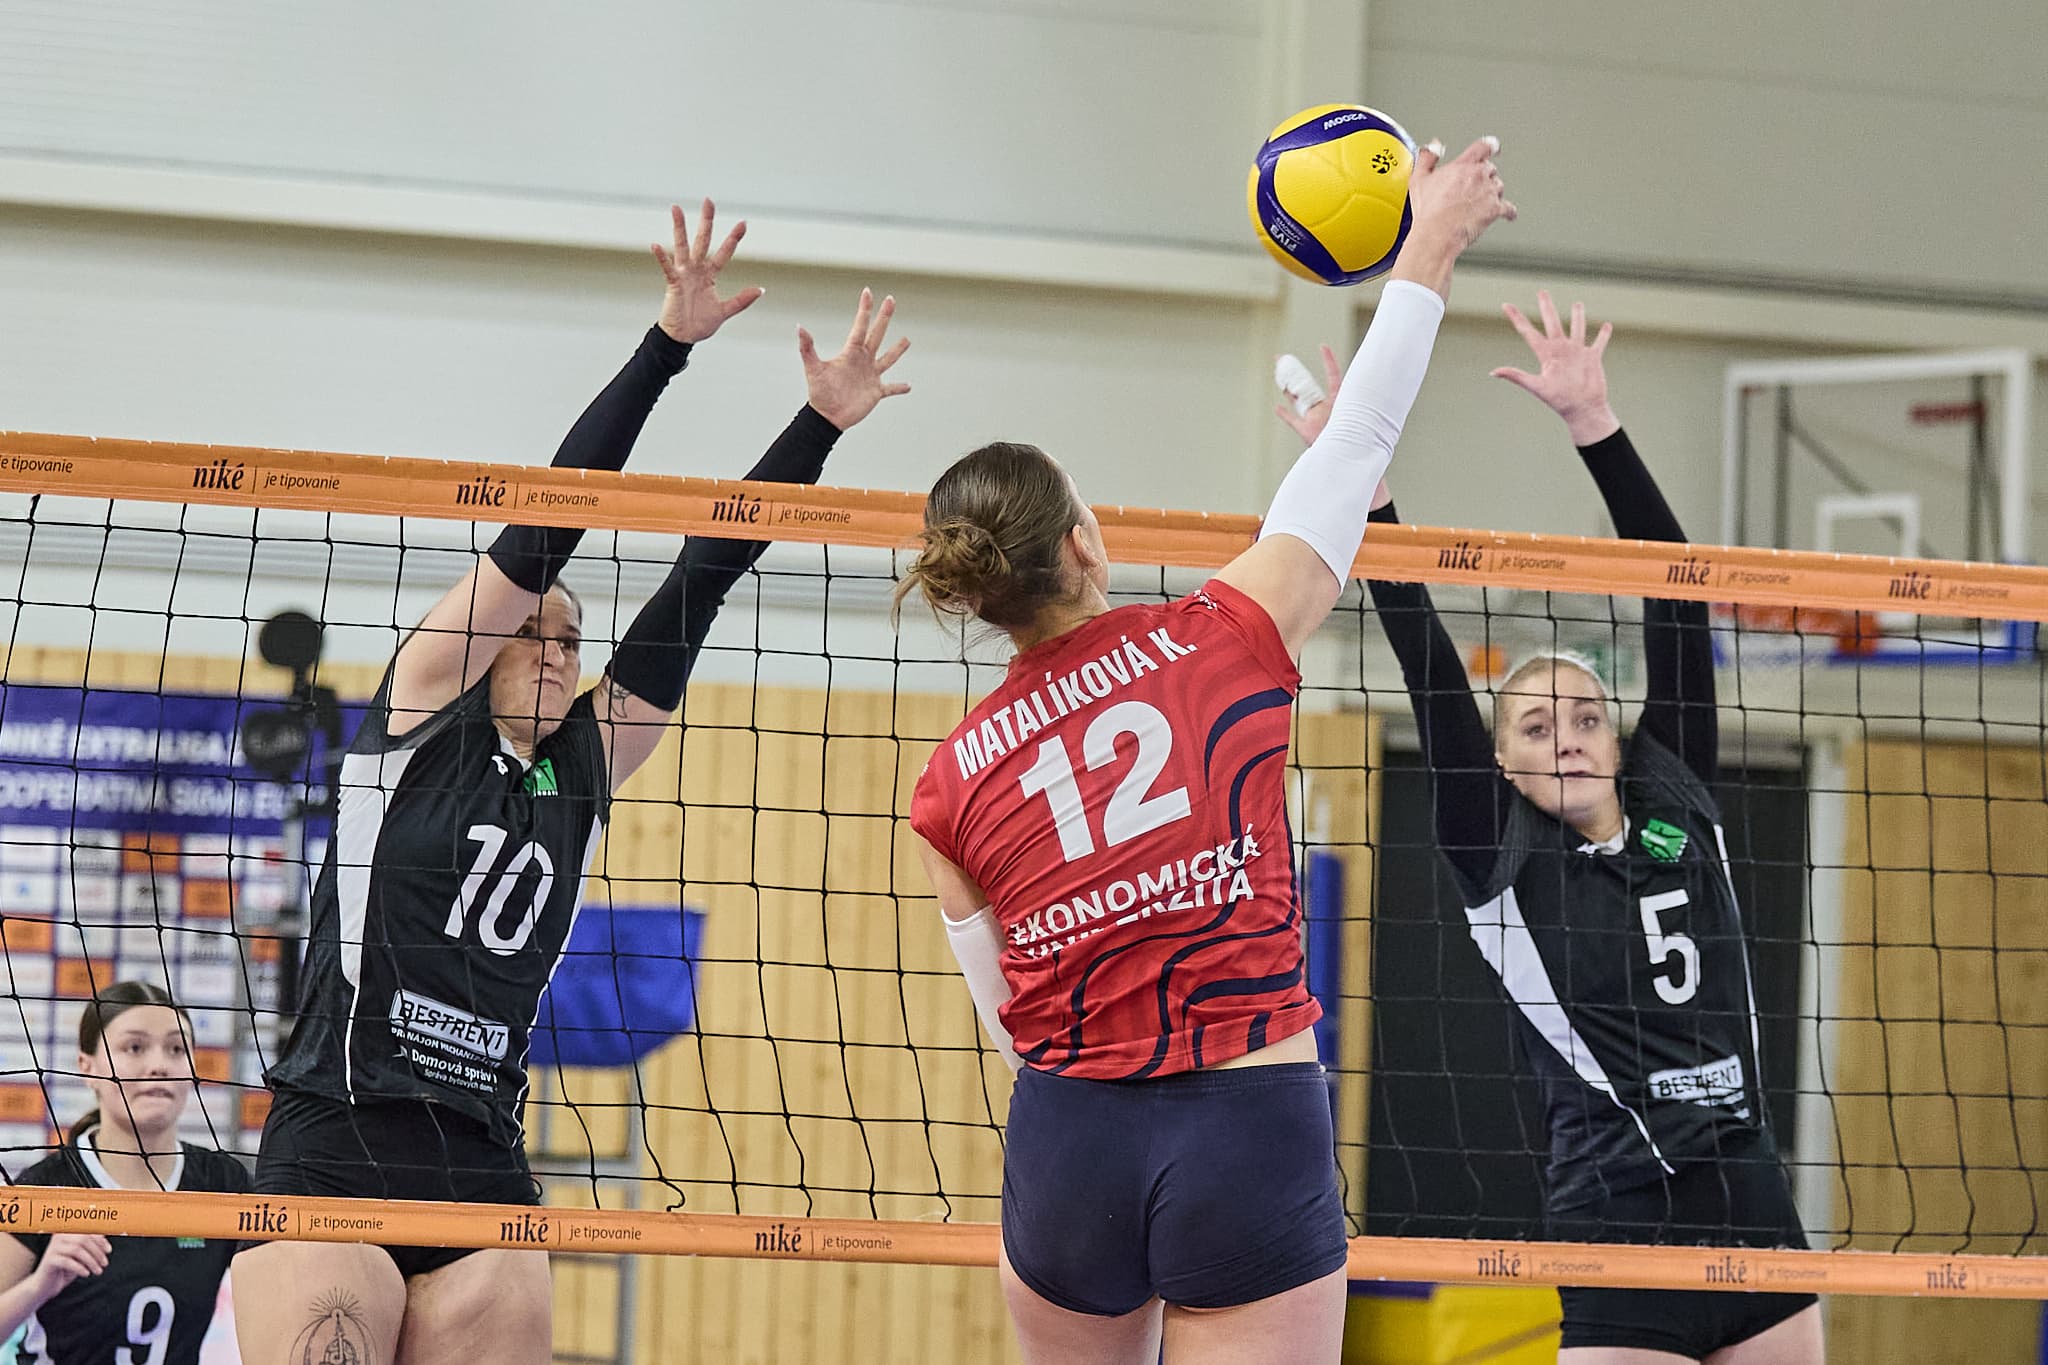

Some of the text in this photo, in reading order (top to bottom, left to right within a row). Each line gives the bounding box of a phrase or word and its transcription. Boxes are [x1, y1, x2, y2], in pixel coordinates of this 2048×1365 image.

[1323, 113, 1367, 130] V200W
[1269, 224, 1298, 252] FIVB
[11, 456, 73, 473] tipovanie
[192, 459, 244, 490] niké
[264, 471, 340, 490] je tipovanie
[456, 476, 506, 507] niké
[525, 489, 599, 508] je tipovanie
[711, 493, 761, 524] niké
[779, 506, 852, 525] je tipovanie
[1437, 541, 1483, 571] niké
[1666, 557, 1711, 586] niké
[1888, 571, 1932, 600] niké
[953, 627, 1198, 781] MATALÍKOVÁ K.
[1018, 701, 1192, 863] 12
[444, 825, 554, 957] 10
[1639, 888, 1700, 1005] 5
[399, 1000, 505, 1051] BESTRENT
[412, 1049, 462, 1075] Domová
[41, 1205, 118, 1222] je tipovanie
[238, 1203, 288, 1233] niké
[308, 1214, 384, 1231] je tipovanie
[500, 1213, 549, 1243] niké
[569, 1225, 642, 1241] je tipovanie
[755, 1224, 801, 1252] niké
[822, 1235, 892, 1250] je tipovanie
[1477, 1250, 1521, 1277] niké
[1705, 1256, 1747, 1283] niké
[1927, 1263, 1967, 1289] niké
[115, 1285, 176, 1365] 9
